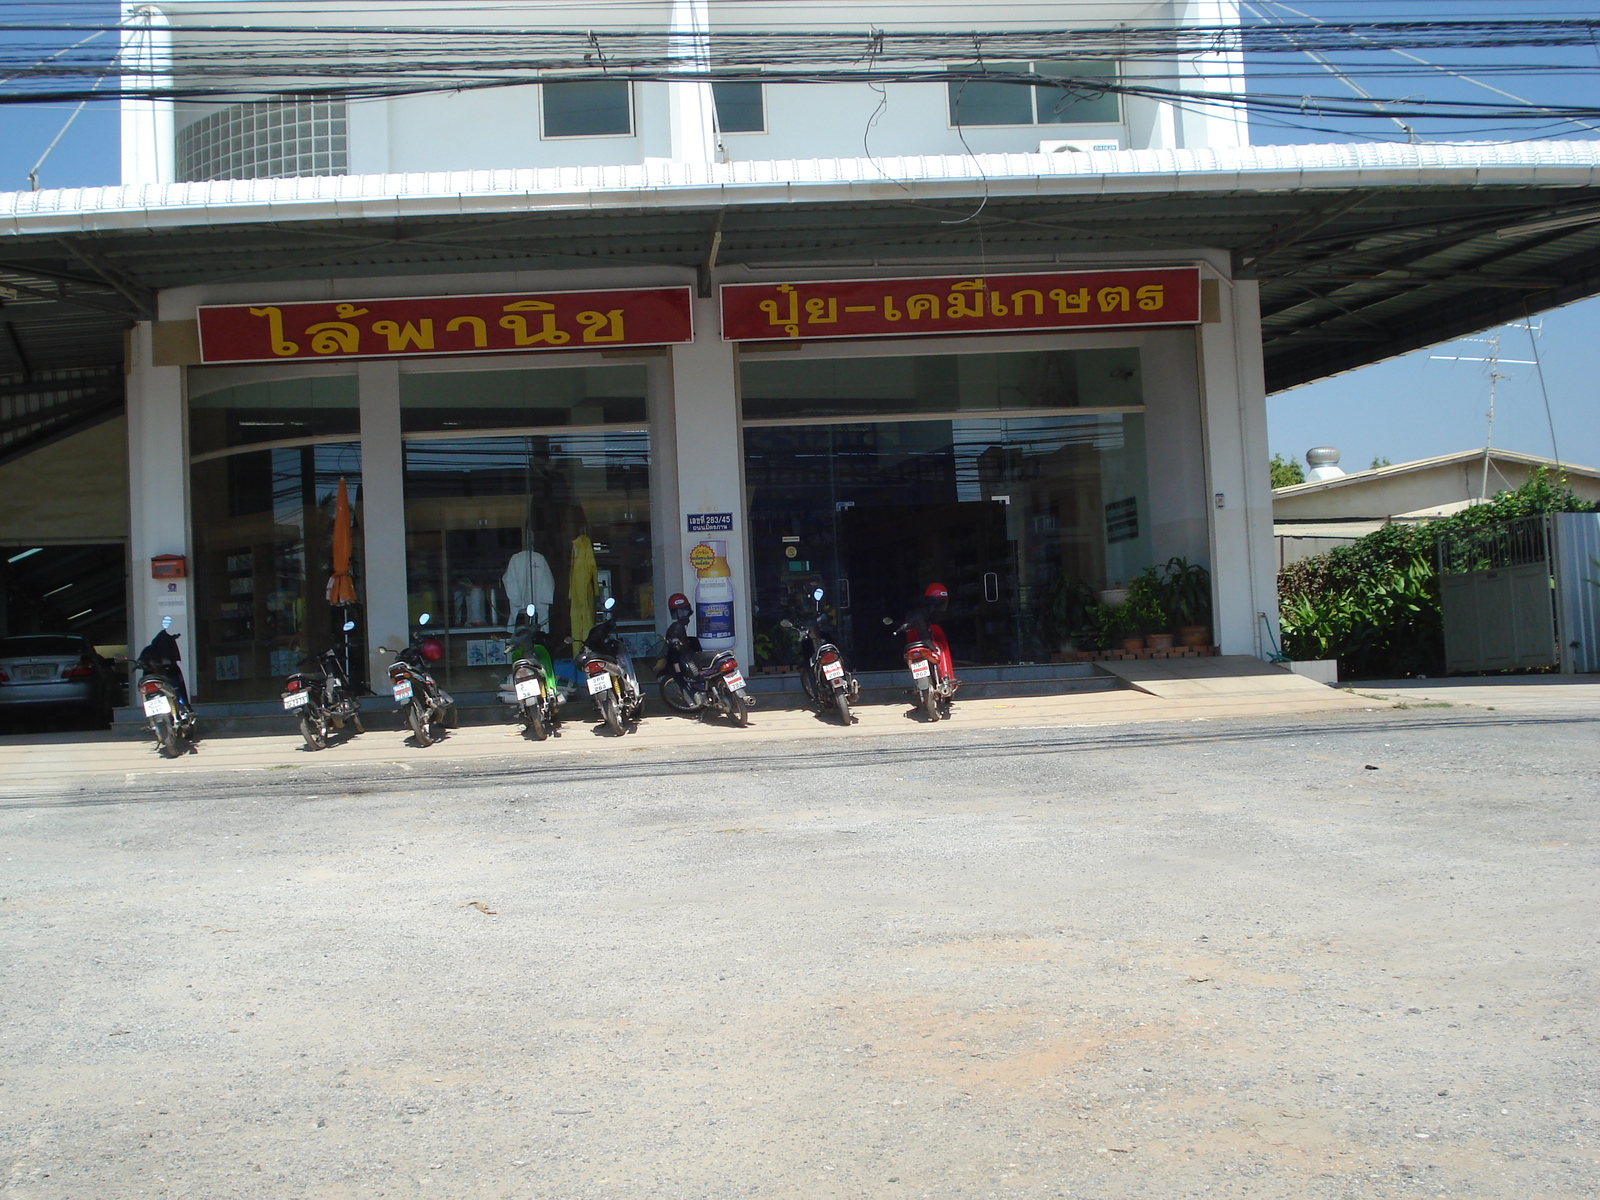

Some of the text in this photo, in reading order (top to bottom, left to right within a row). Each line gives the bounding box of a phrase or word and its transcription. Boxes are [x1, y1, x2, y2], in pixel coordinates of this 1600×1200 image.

[249, 300, 626, 356] ไล้พานิช
[759, 278, 1164, 338] ปุ๋ย-เคมีเกษตร
[706, 515, 731, 524] 283/45
